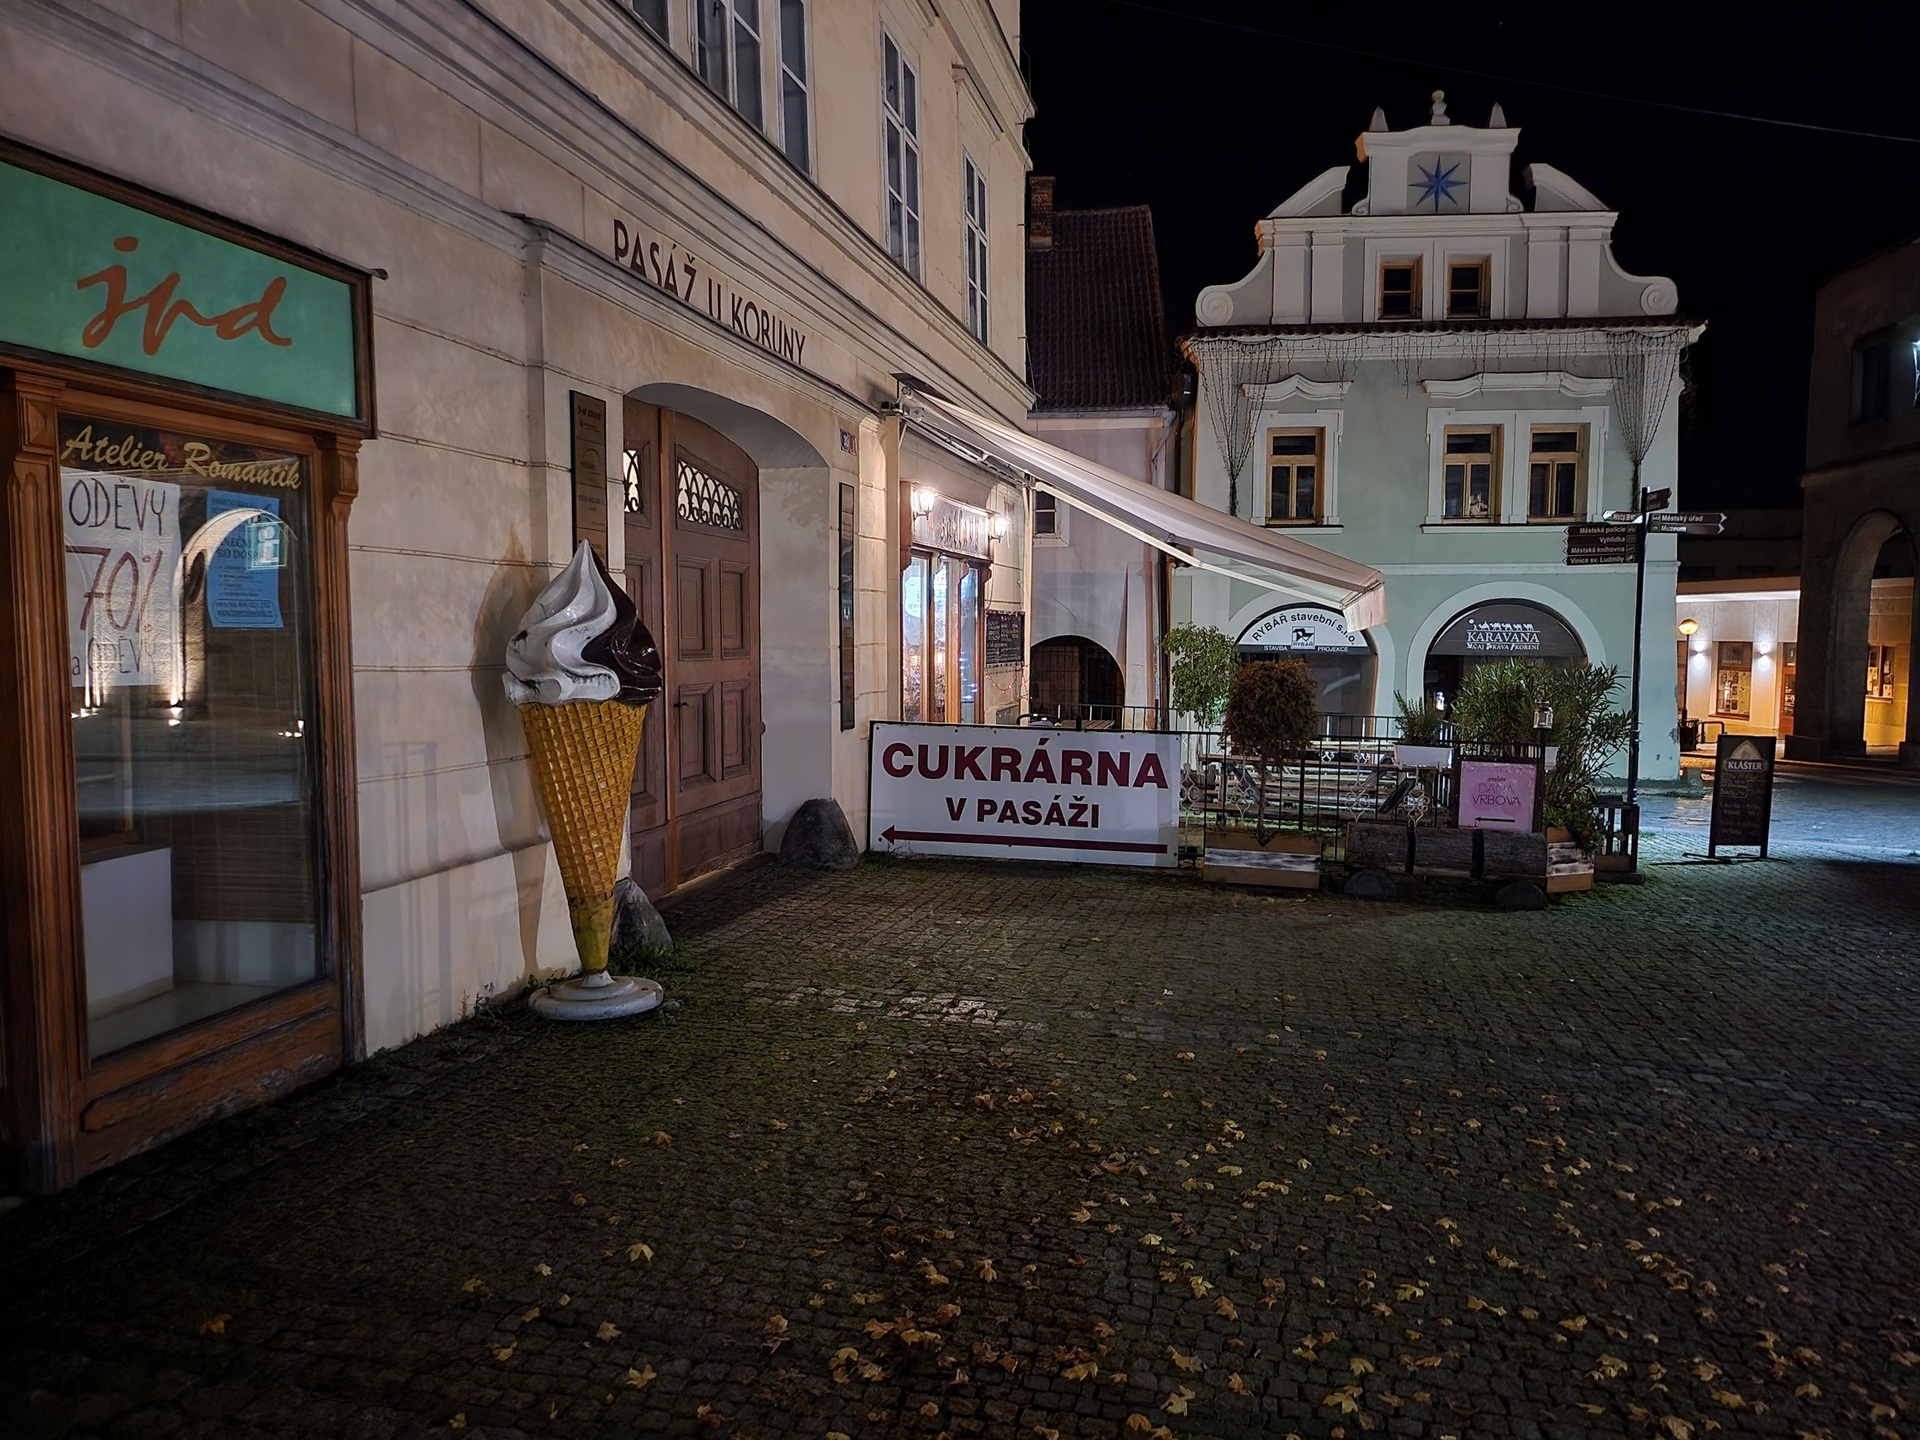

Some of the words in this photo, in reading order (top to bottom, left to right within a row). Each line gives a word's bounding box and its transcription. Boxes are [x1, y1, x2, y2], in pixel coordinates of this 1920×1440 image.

[613, 219, 697, 303] PASÁŽ
[708, 277, 721, 320] U
[731, 292, 806, 365] KORUNY
[61, 425, 169, 471] Atelier
[183, 442, 302, 490] Romantik
[69, 477, 166, 536] ODĚVY
[1662, 513, 1687, 522] Městský
[1688, 514, 1704, 522] úřad
[1605, 526, 1626, 534] policie
[1660, 525, 1687, 533] Muzeum
[1571, 546, 1596, 554] Městská
[1597, 545, 1625, 553] knihovna
[1599, 535, 1626, 544] Vyhlídka
[1570, 556, 1589, 564] Vinice
[1600, 555, 1624, 563] Ludmily
[66, 544, 163, 634] 70%
[1252, 613, 1288, 641] RYBÁŘ
[1290, 612, 1337, 627] stavební
[1467, 632, 1540, 643] KARAVANA
[882, 737, 1169, 790] CUKRÁRNA
[945, 797, 967, 822] V
[976, 795, 1100, 828] PASÁŽI
